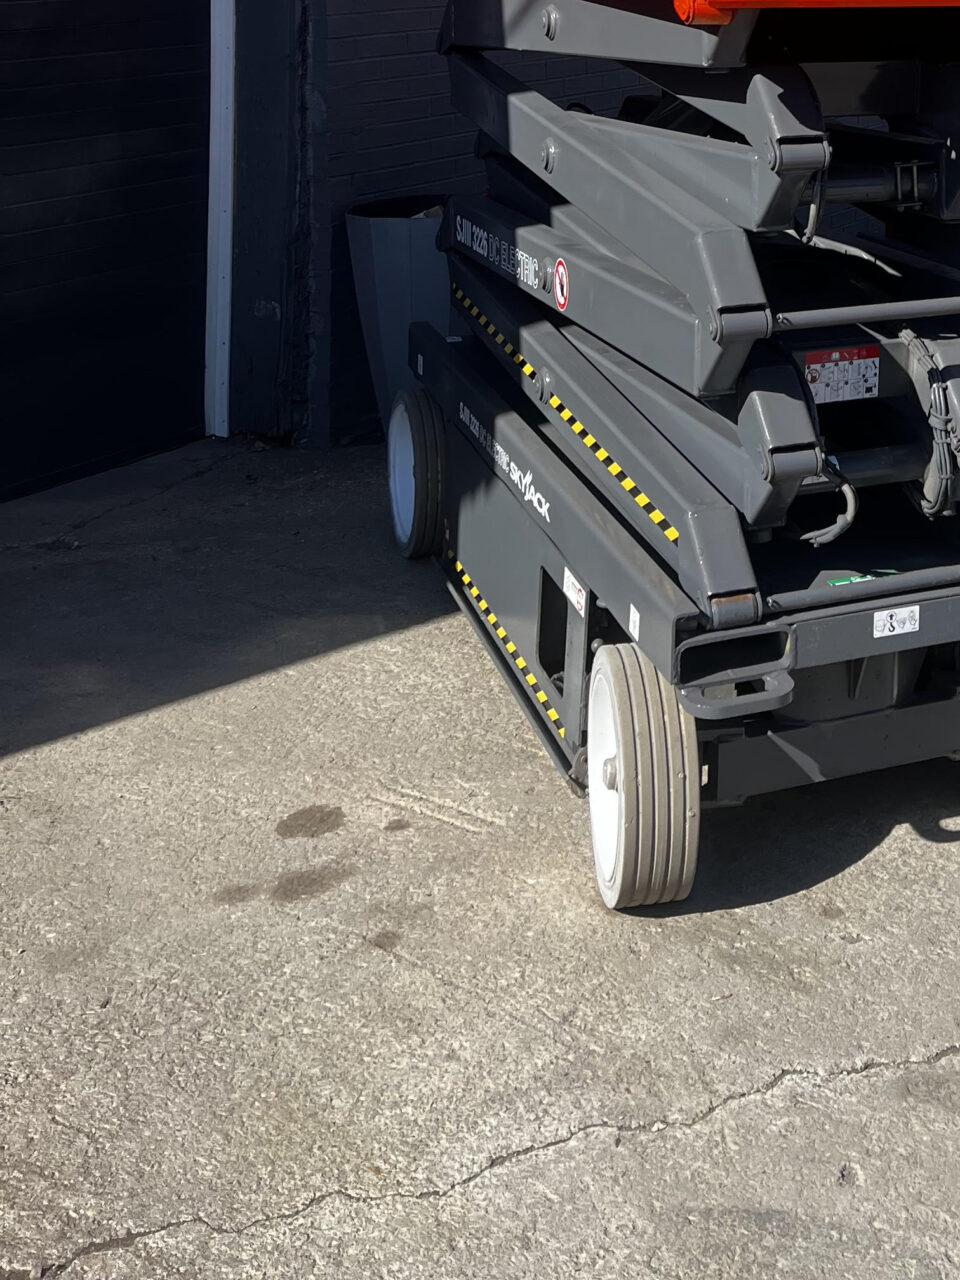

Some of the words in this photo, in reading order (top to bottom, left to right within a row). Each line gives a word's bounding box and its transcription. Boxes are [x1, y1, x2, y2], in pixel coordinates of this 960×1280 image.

[472, 224, 488, 258] 3226
[501, 241, 539, 289] ELECTRIC
[510, 461, 551, 523] SKYJACK
